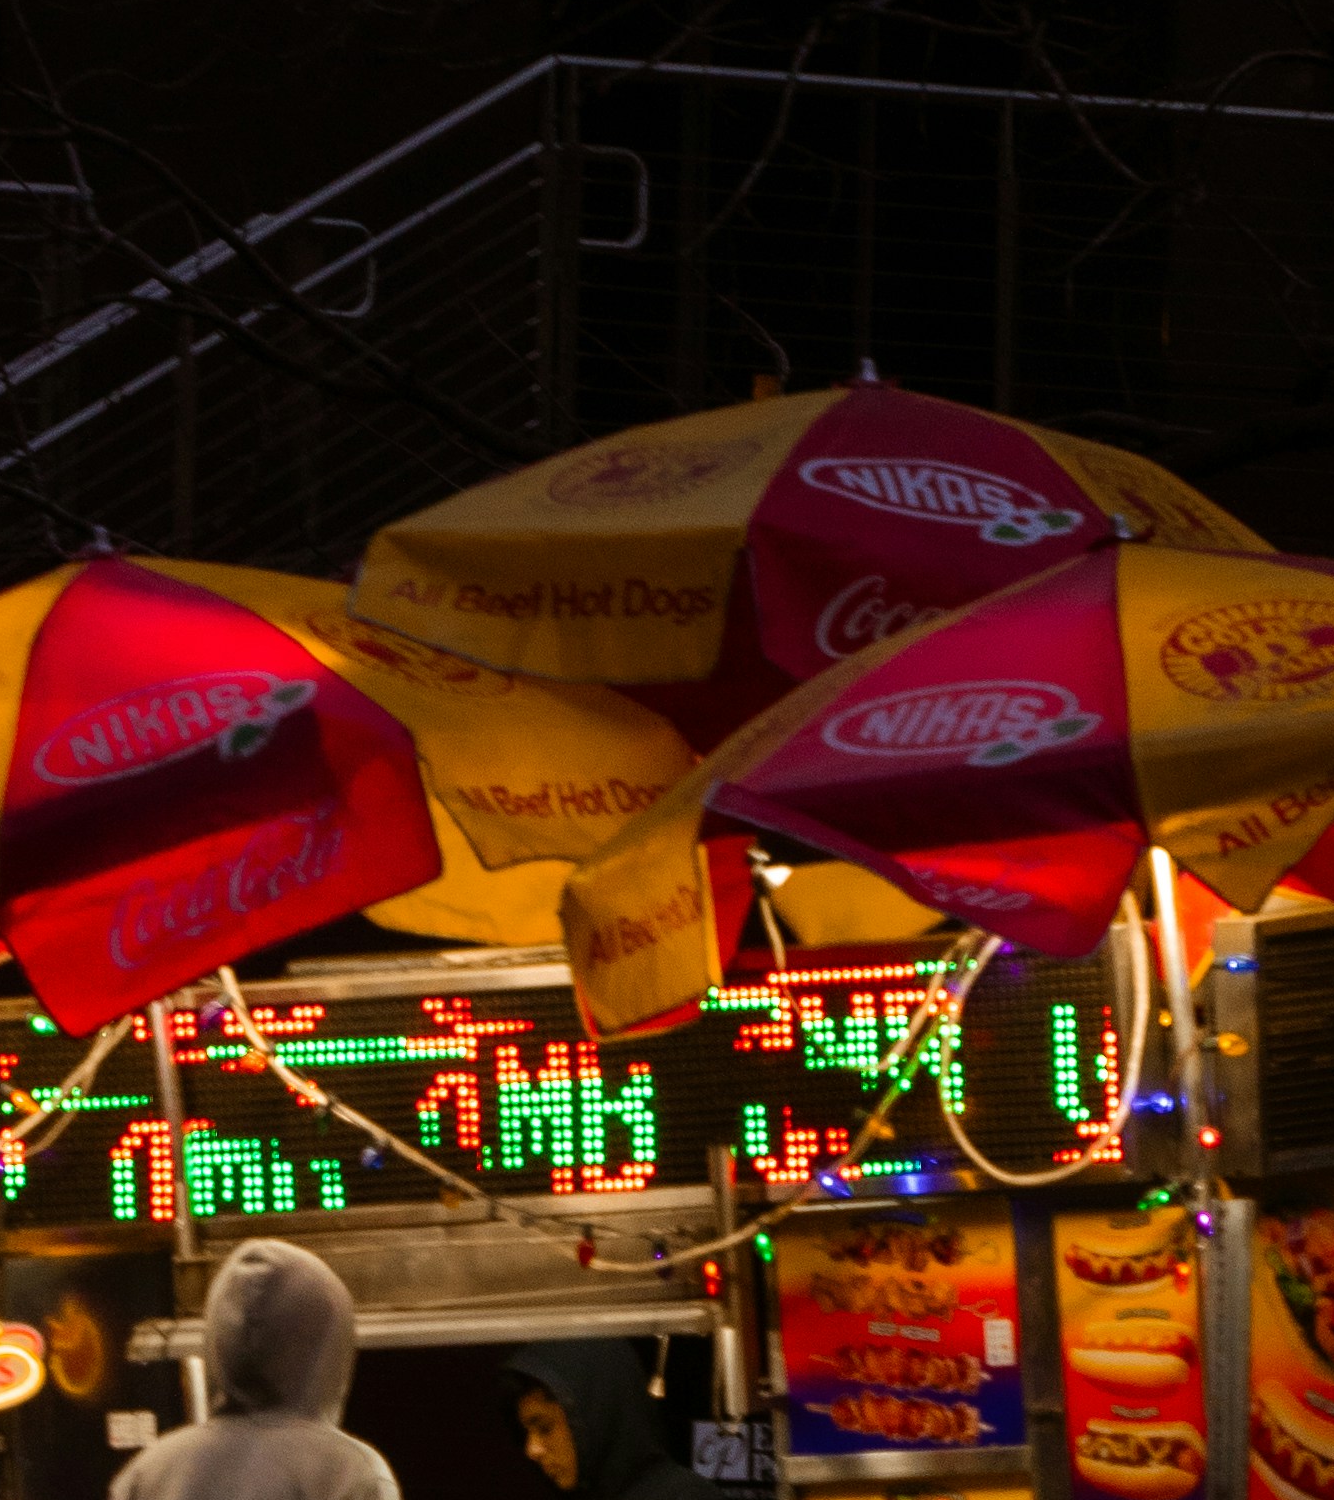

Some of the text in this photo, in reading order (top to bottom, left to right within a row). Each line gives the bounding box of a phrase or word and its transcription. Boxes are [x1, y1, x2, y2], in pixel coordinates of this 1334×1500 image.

[837, 466, 1015, 516] NIKAS
[548, 580, 613, 618] Hot
[621, 577, 713, 626] Dogs
[67, 683, 254, 767] NIKAS
[860, 691, 1047, 743] NIKAS
[1217, 813, 1269, 857] All
[108, 798, 346, 972] Coca-Cola
